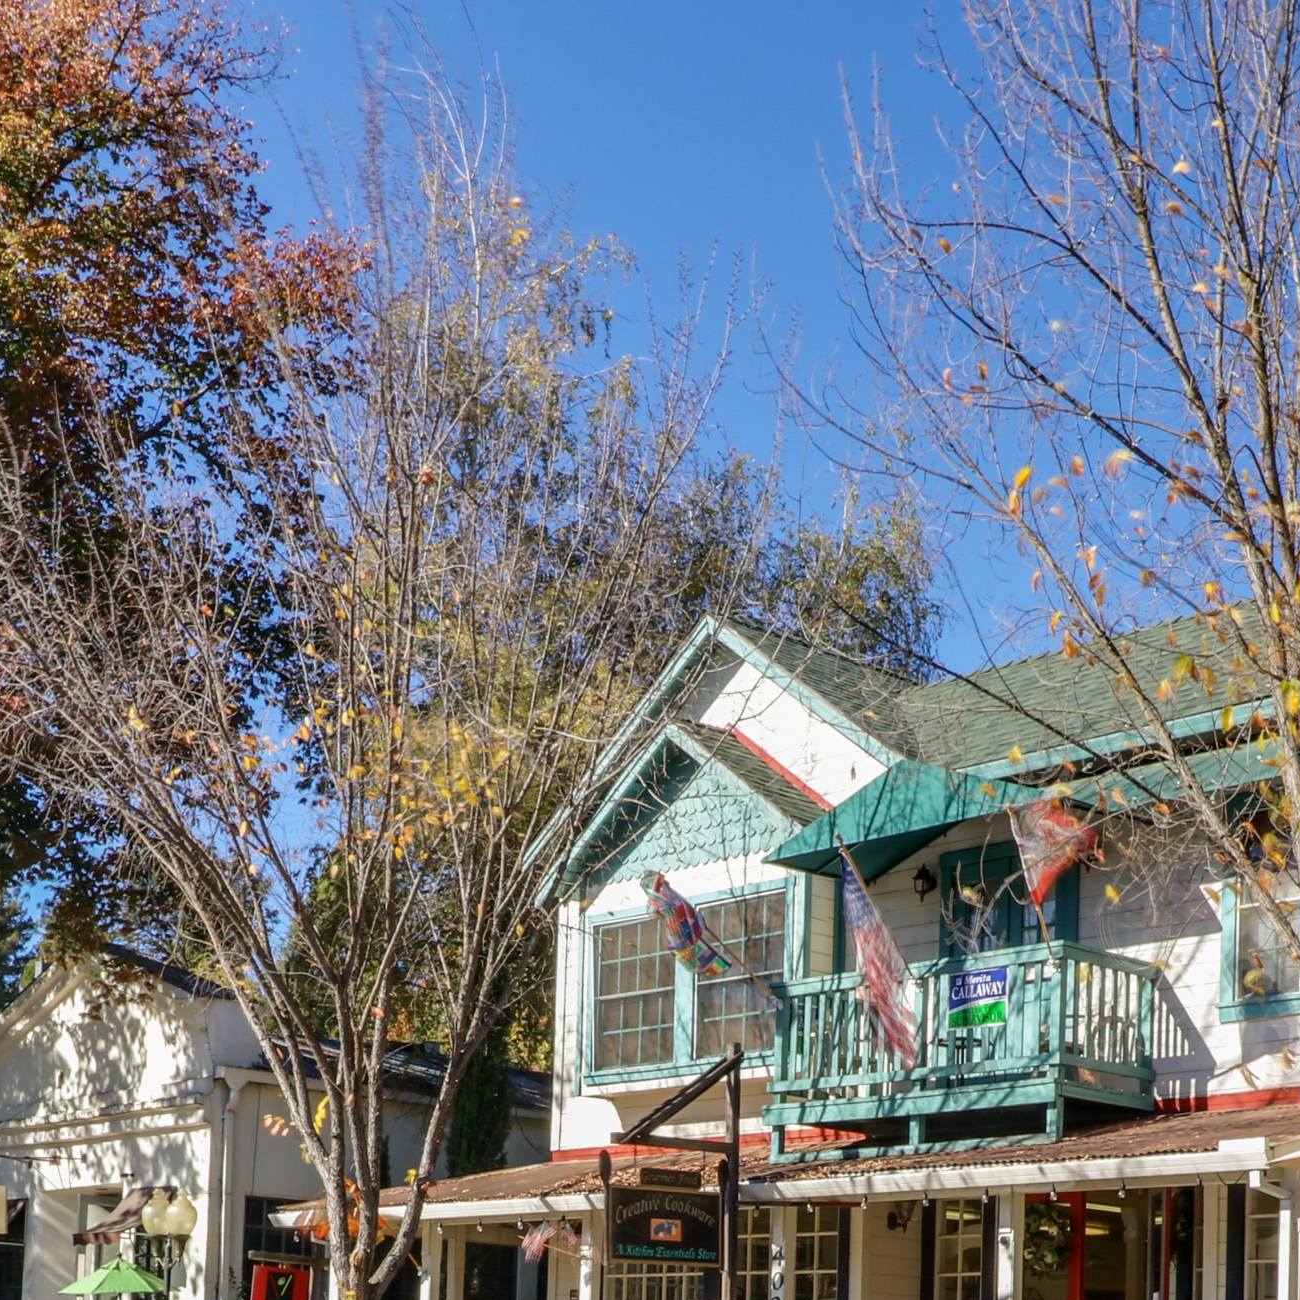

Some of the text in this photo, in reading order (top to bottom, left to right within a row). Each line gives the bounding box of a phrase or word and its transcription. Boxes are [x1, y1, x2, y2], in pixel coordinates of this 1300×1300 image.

[965, 974, 991, 984] Merita
[951, 981, 1004, 1000] CALLAWAY
[951, 1012, 1002, 1026] SUPRVISOR
[642, 1171, 697, 1185] Gourmet Food
[615, 1195, 715, 1227] Creative Cookware
[615, 1244, 717, 1260] A Kitchen Essentials Store
